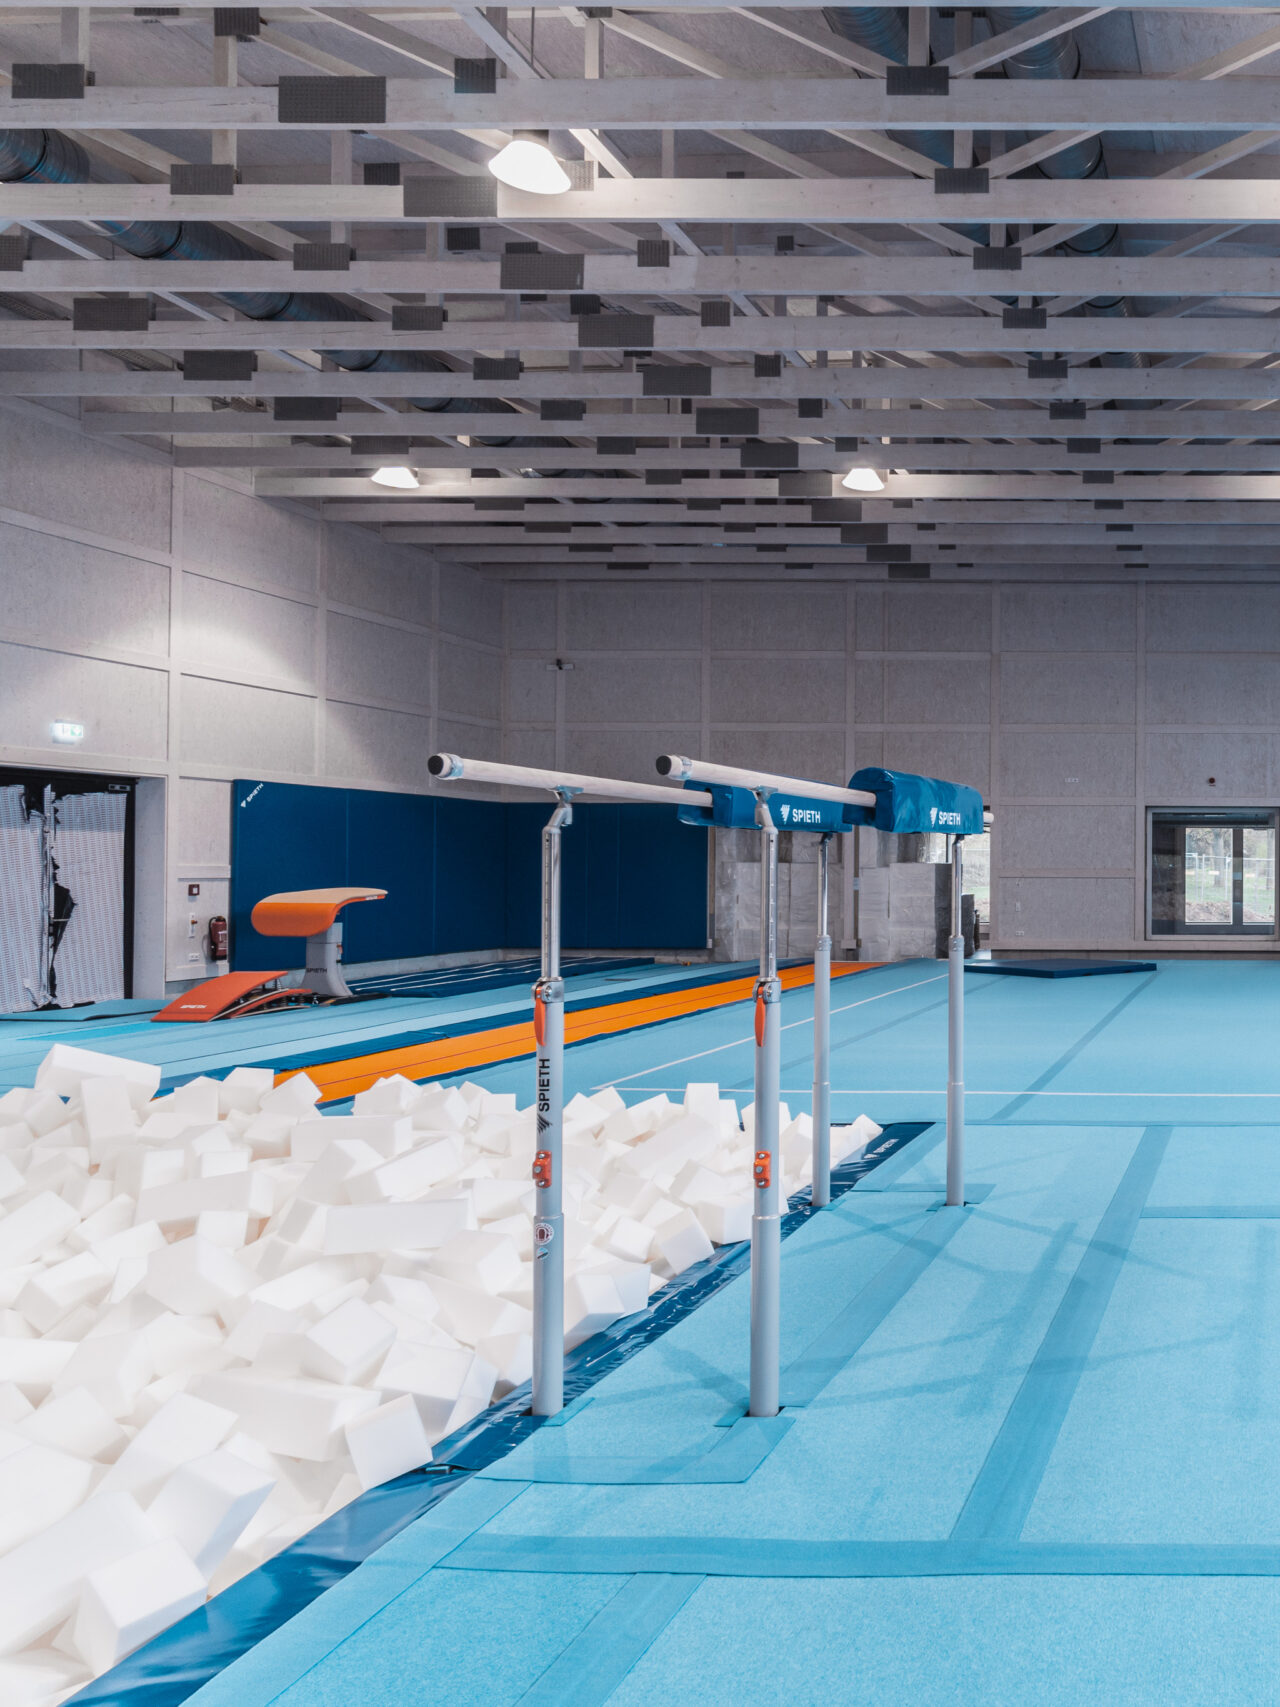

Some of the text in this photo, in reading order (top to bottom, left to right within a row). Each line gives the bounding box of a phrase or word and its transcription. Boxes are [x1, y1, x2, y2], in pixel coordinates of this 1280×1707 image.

[792, 808, 821, 824] SPIETH
[938, 811, 961, 826] SPIETH
[538, 1058, 551, 1112] SPIETH
